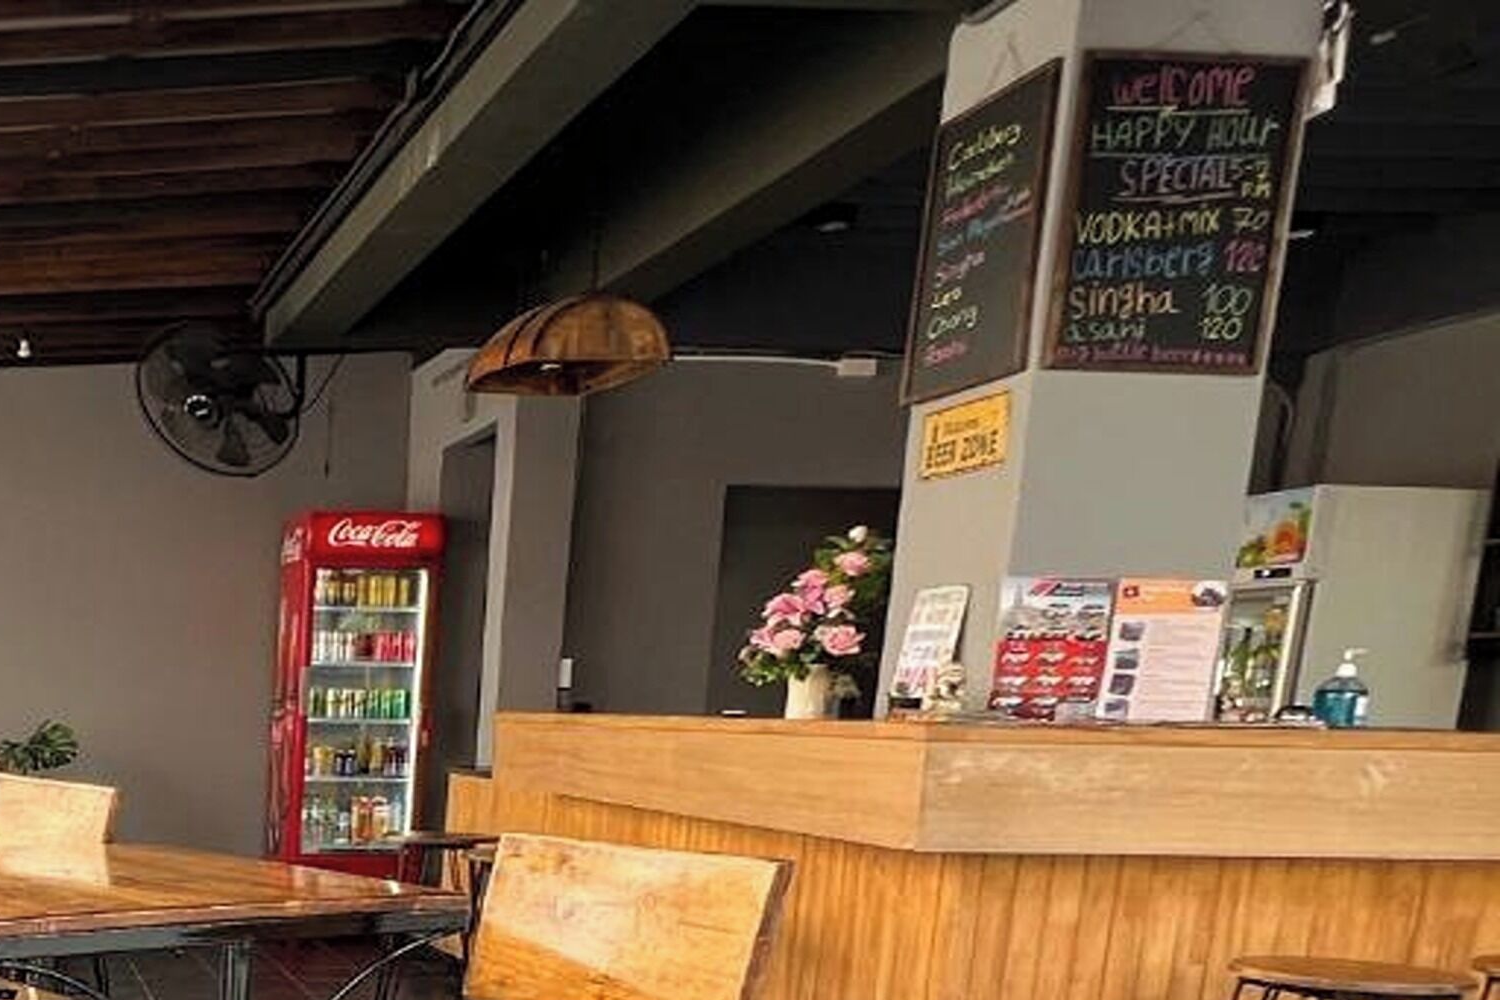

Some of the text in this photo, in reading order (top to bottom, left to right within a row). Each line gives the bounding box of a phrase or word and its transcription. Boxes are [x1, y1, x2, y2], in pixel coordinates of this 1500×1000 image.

[1091, 114, 1196, 149] HAPPY
[1232, 207, 1270, 231] 70
[1202, 283, 1253, 316] 100
[1199, 317, 1243, 340] 120
[328, 518, 422, 548] Coca-Cola
